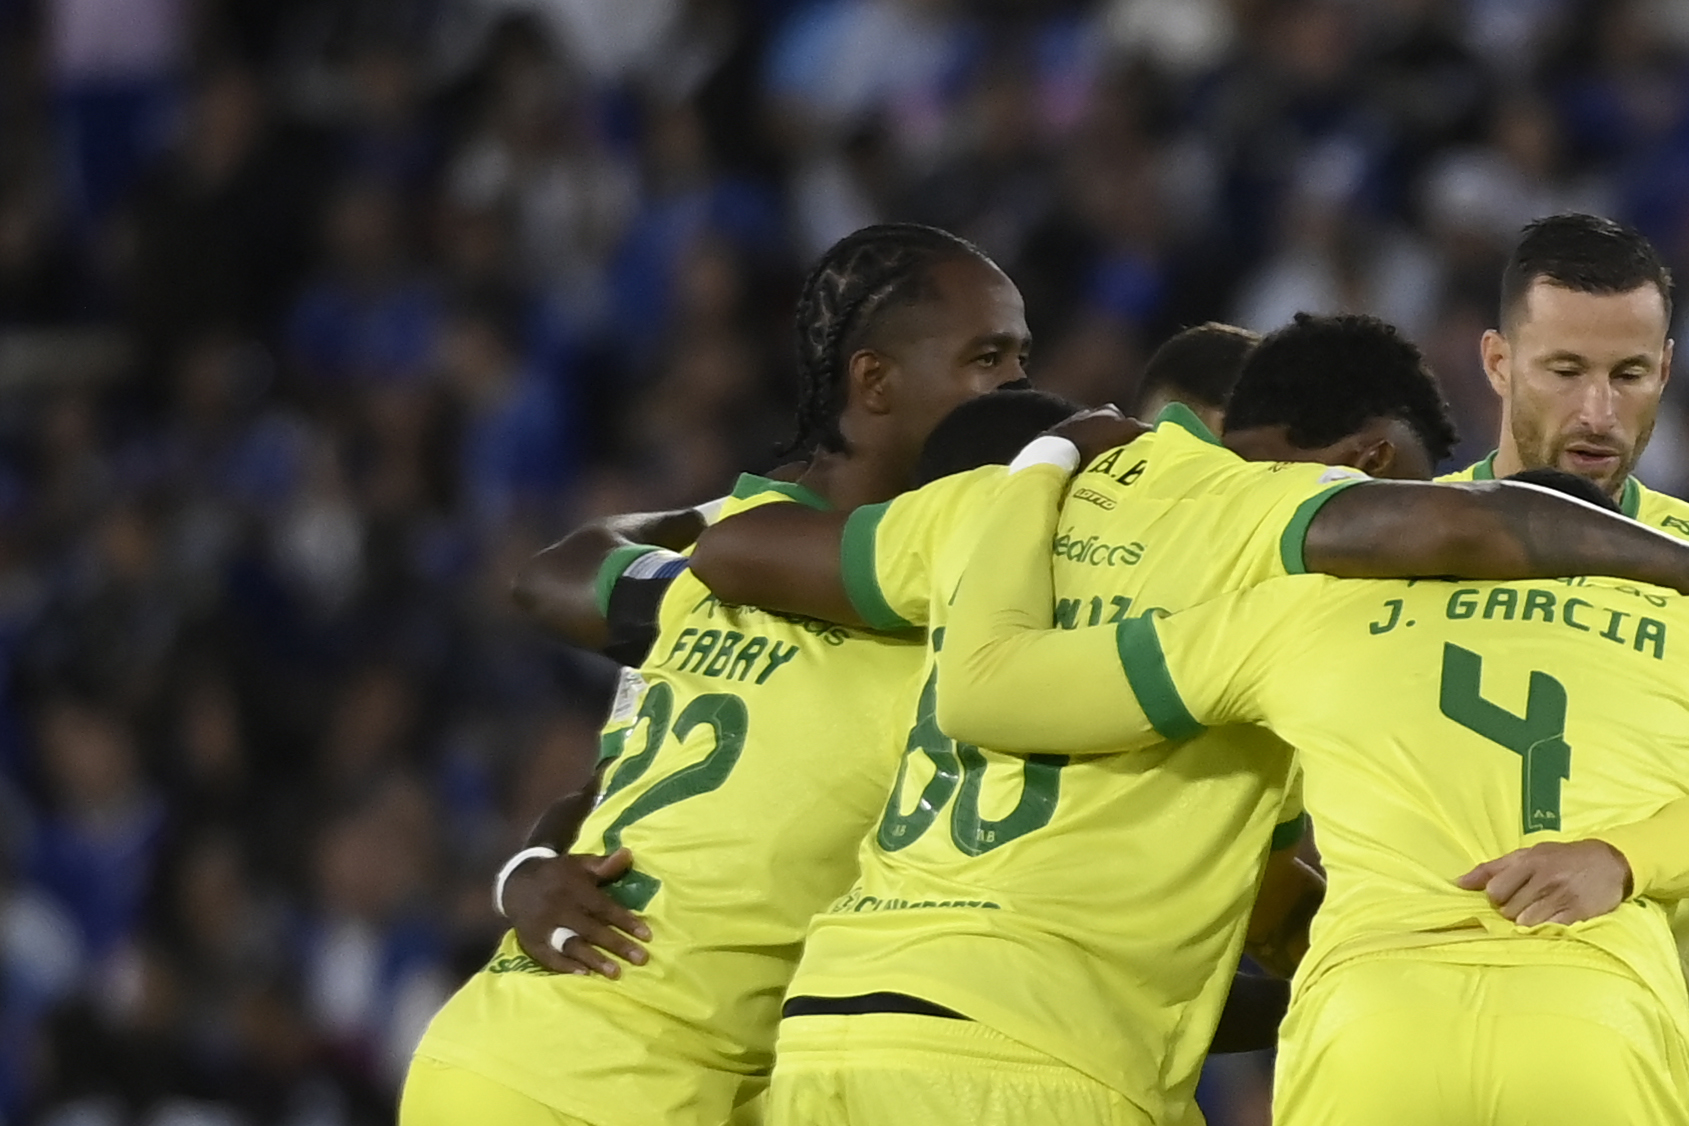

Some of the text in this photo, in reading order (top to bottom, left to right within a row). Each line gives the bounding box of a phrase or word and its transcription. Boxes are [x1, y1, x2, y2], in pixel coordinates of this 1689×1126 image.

[1369, 599, 1416, 635] J.
[1446, 588, 1667, 660] GARCIA
[1440, 641, 1571, 835] 4
